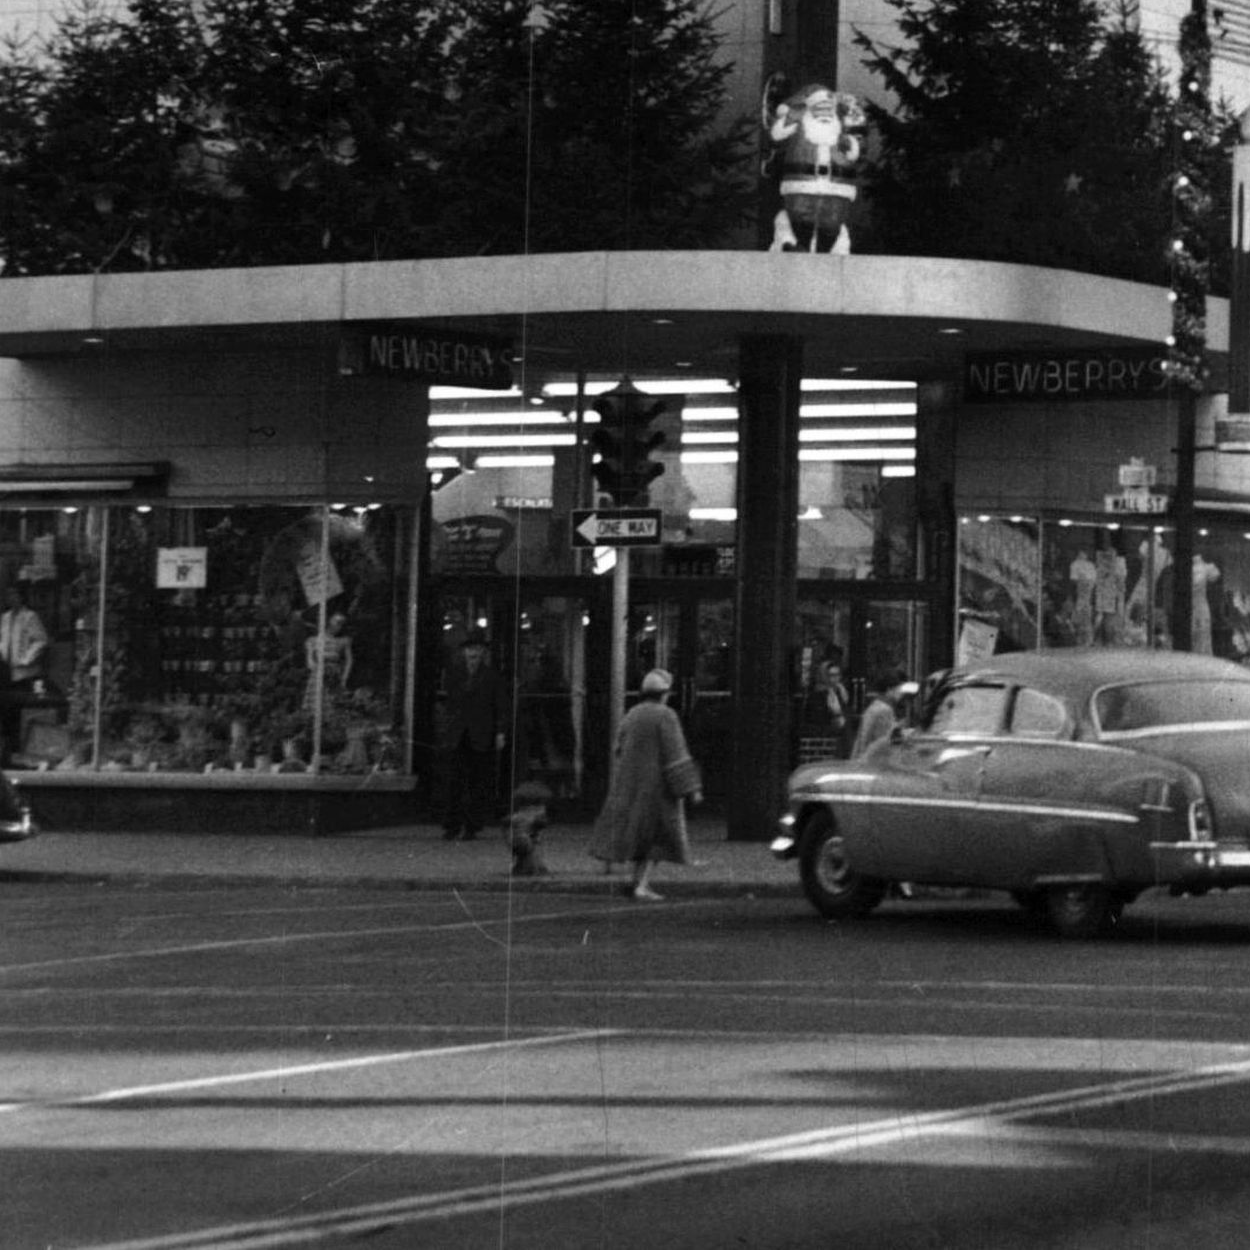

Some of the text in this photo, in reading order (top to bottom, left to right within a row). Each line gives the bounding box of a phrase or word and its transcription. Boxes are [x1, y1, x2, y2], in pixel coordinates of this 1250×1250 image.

[1147, 497, 1163, 511] ST
[597, 520, 655, 535] ONE WAY
